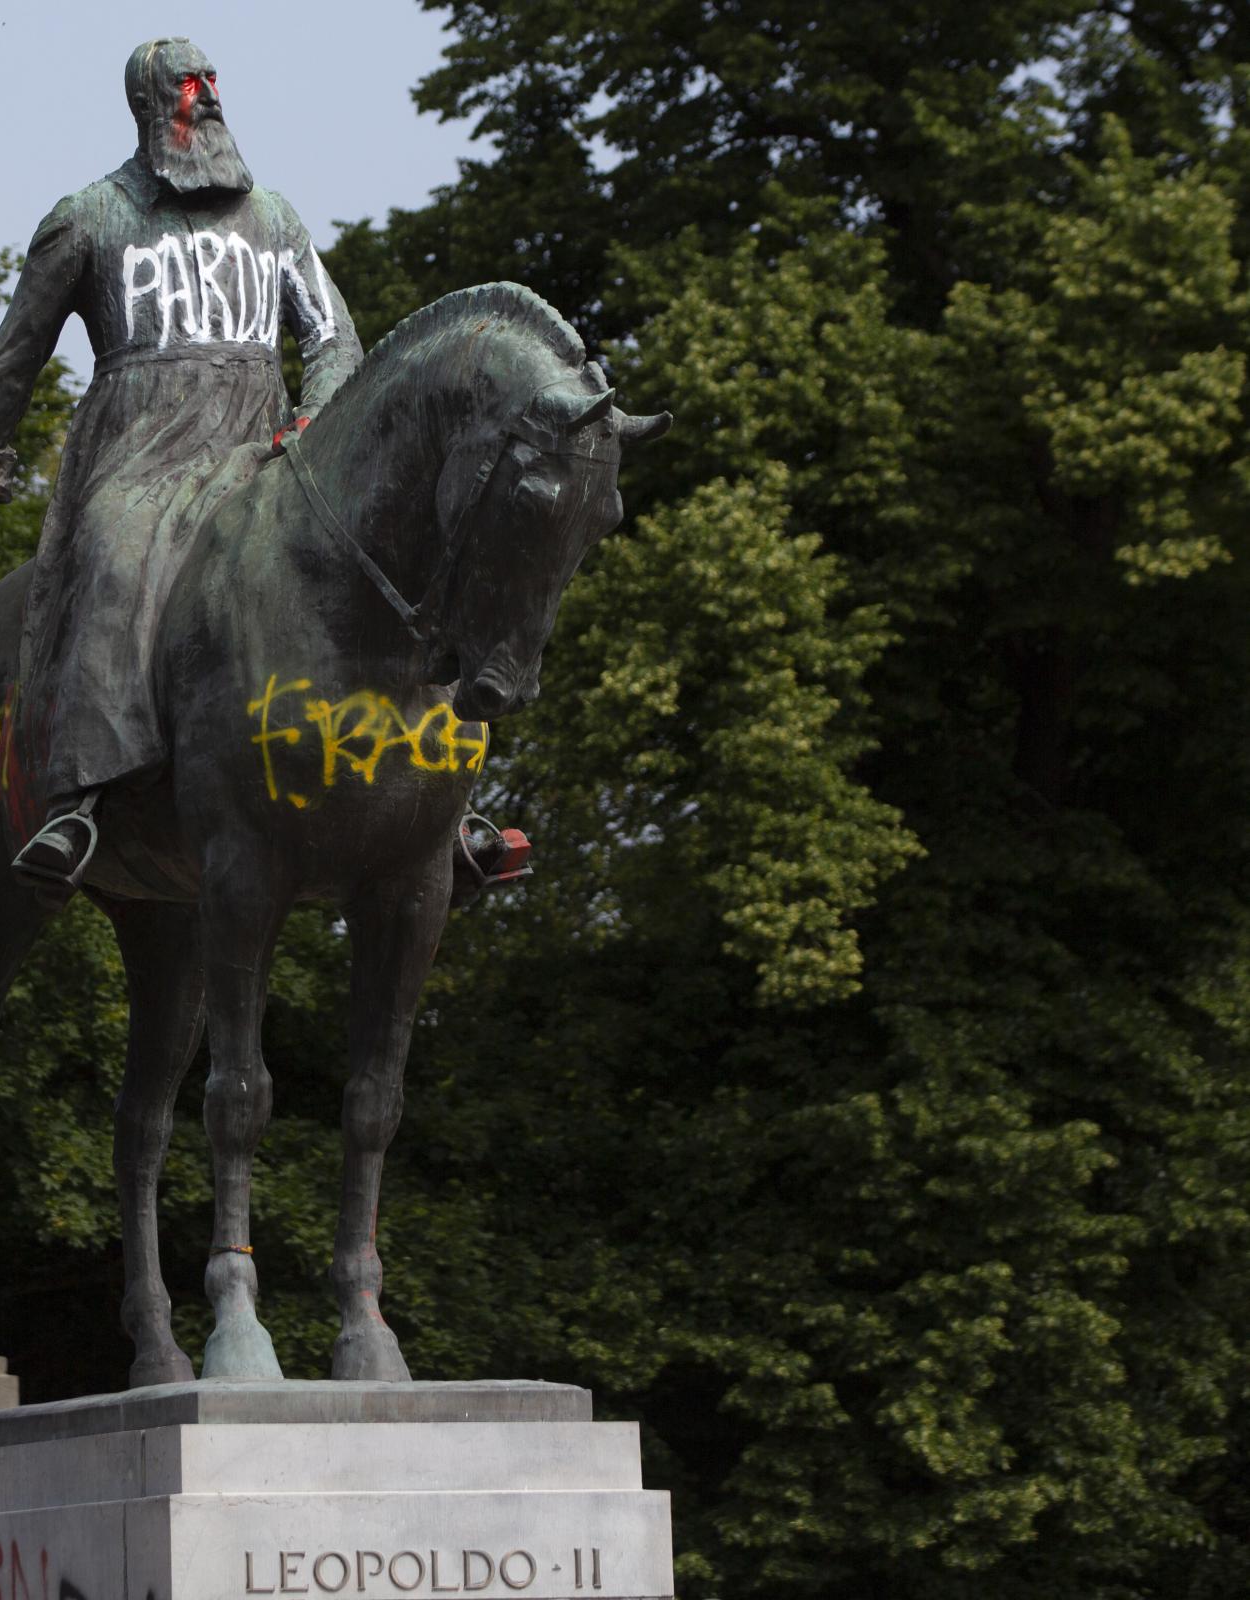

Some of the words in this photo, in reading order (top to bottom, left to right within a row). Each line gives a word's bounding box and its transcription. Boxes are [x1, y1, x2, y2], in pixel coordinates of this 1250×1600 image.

[123, 231, 336, 349] PARDON
[245, 1549, 537, 1594] LEOPOLDO
[573, 1547, 602, 1590] II
